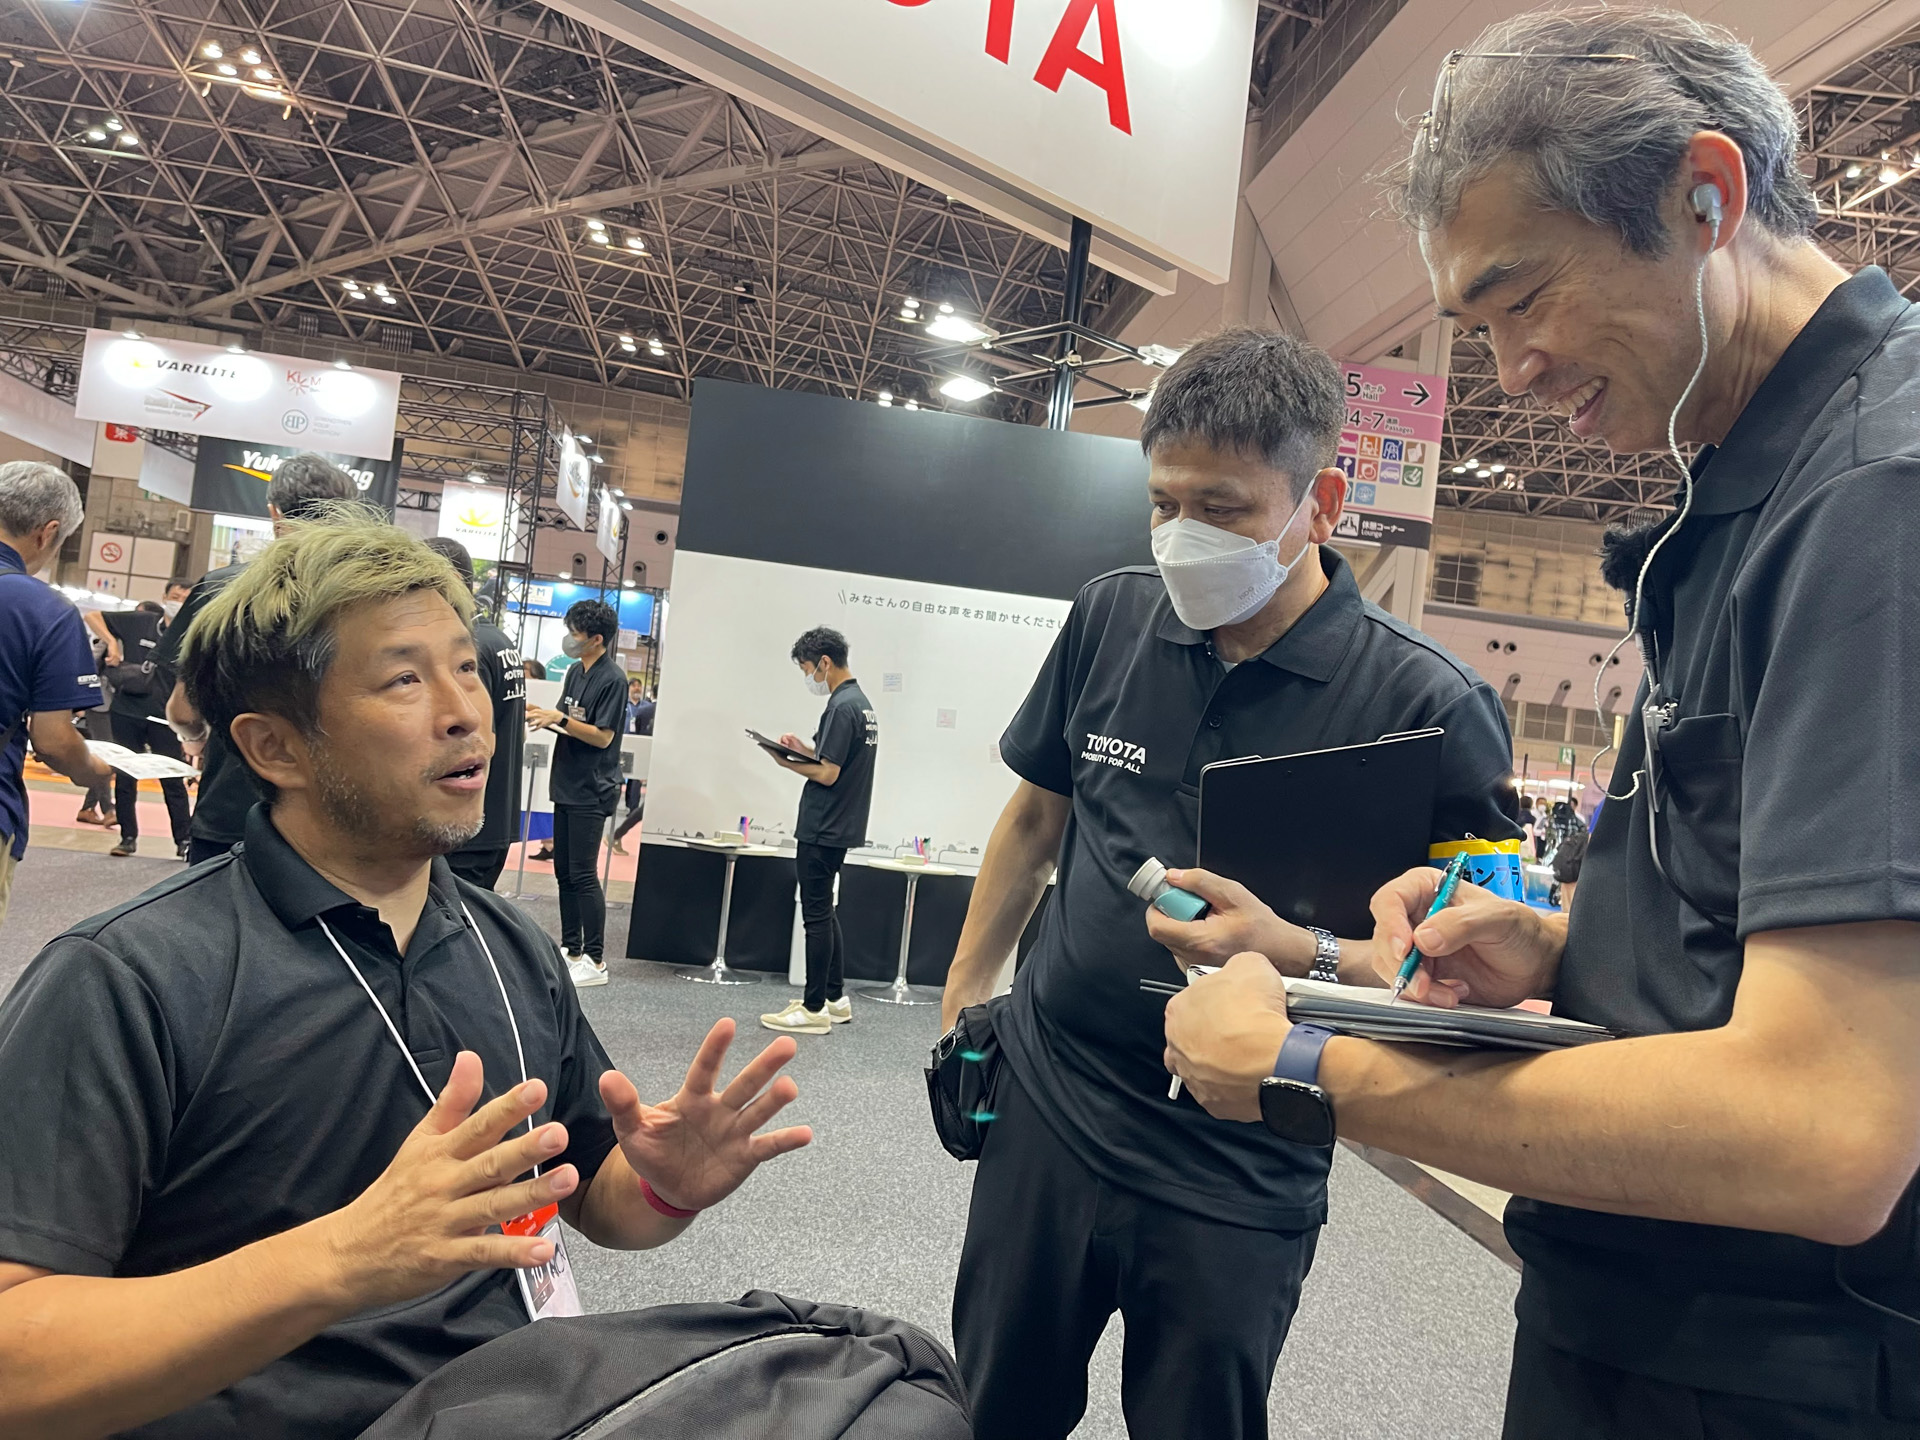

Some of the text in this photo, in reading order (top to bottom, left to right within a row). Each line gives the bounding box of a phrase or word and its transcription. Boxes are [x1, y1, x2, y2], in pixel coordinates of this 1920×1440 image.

[1362, 390, 1379, 401] Hall
[1086, 733, 1147, 765] TOYOTA
[1107, 756, 1124, 768] FOR
[1124, 762, 1142, 775] ALL
